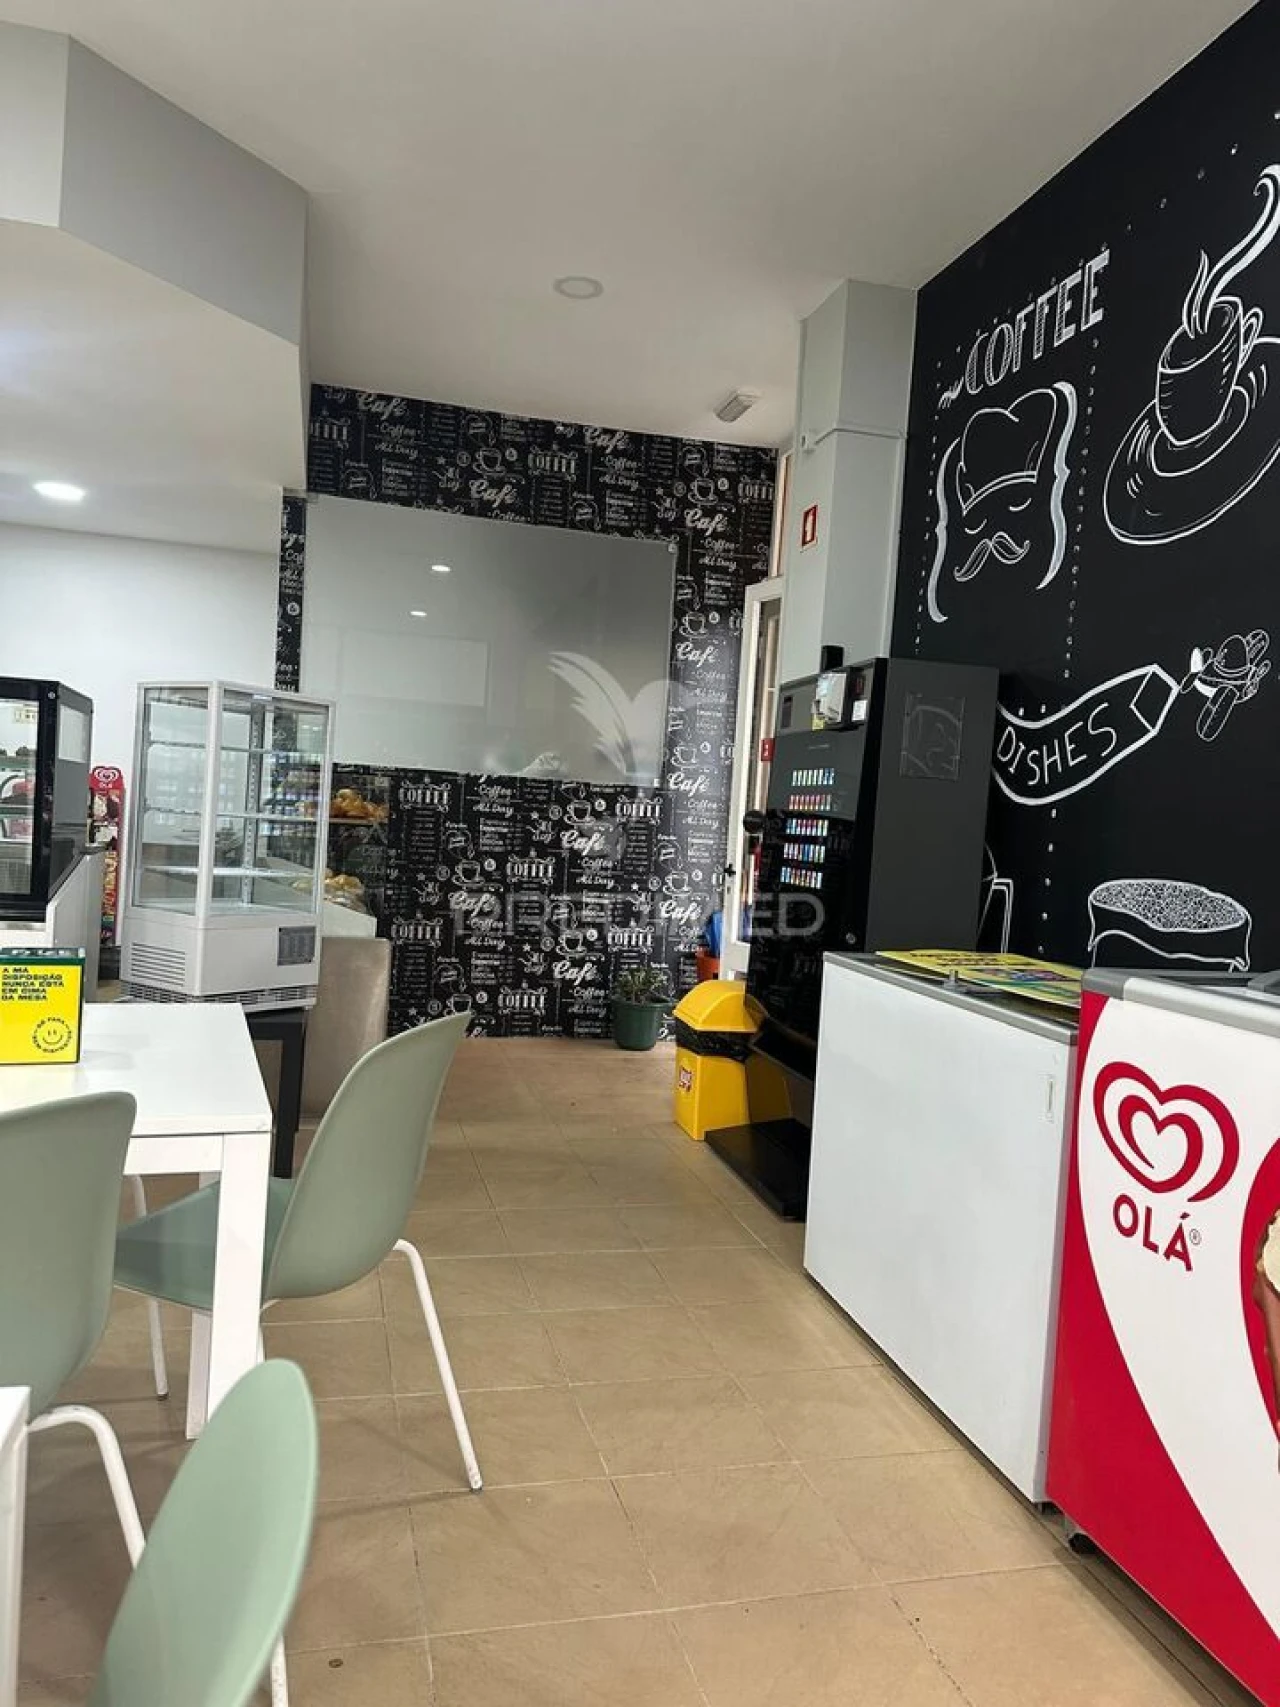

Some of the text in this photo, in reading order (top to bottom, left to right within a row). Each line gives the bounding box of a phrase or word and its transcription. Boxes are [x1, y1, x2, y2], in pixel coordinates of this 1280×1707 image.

[964, 248, 1110, 394] COFFEE
[997, 702, 1117, 786] DISHES
[1113, 1193, 1193, 1272] OLÁ
